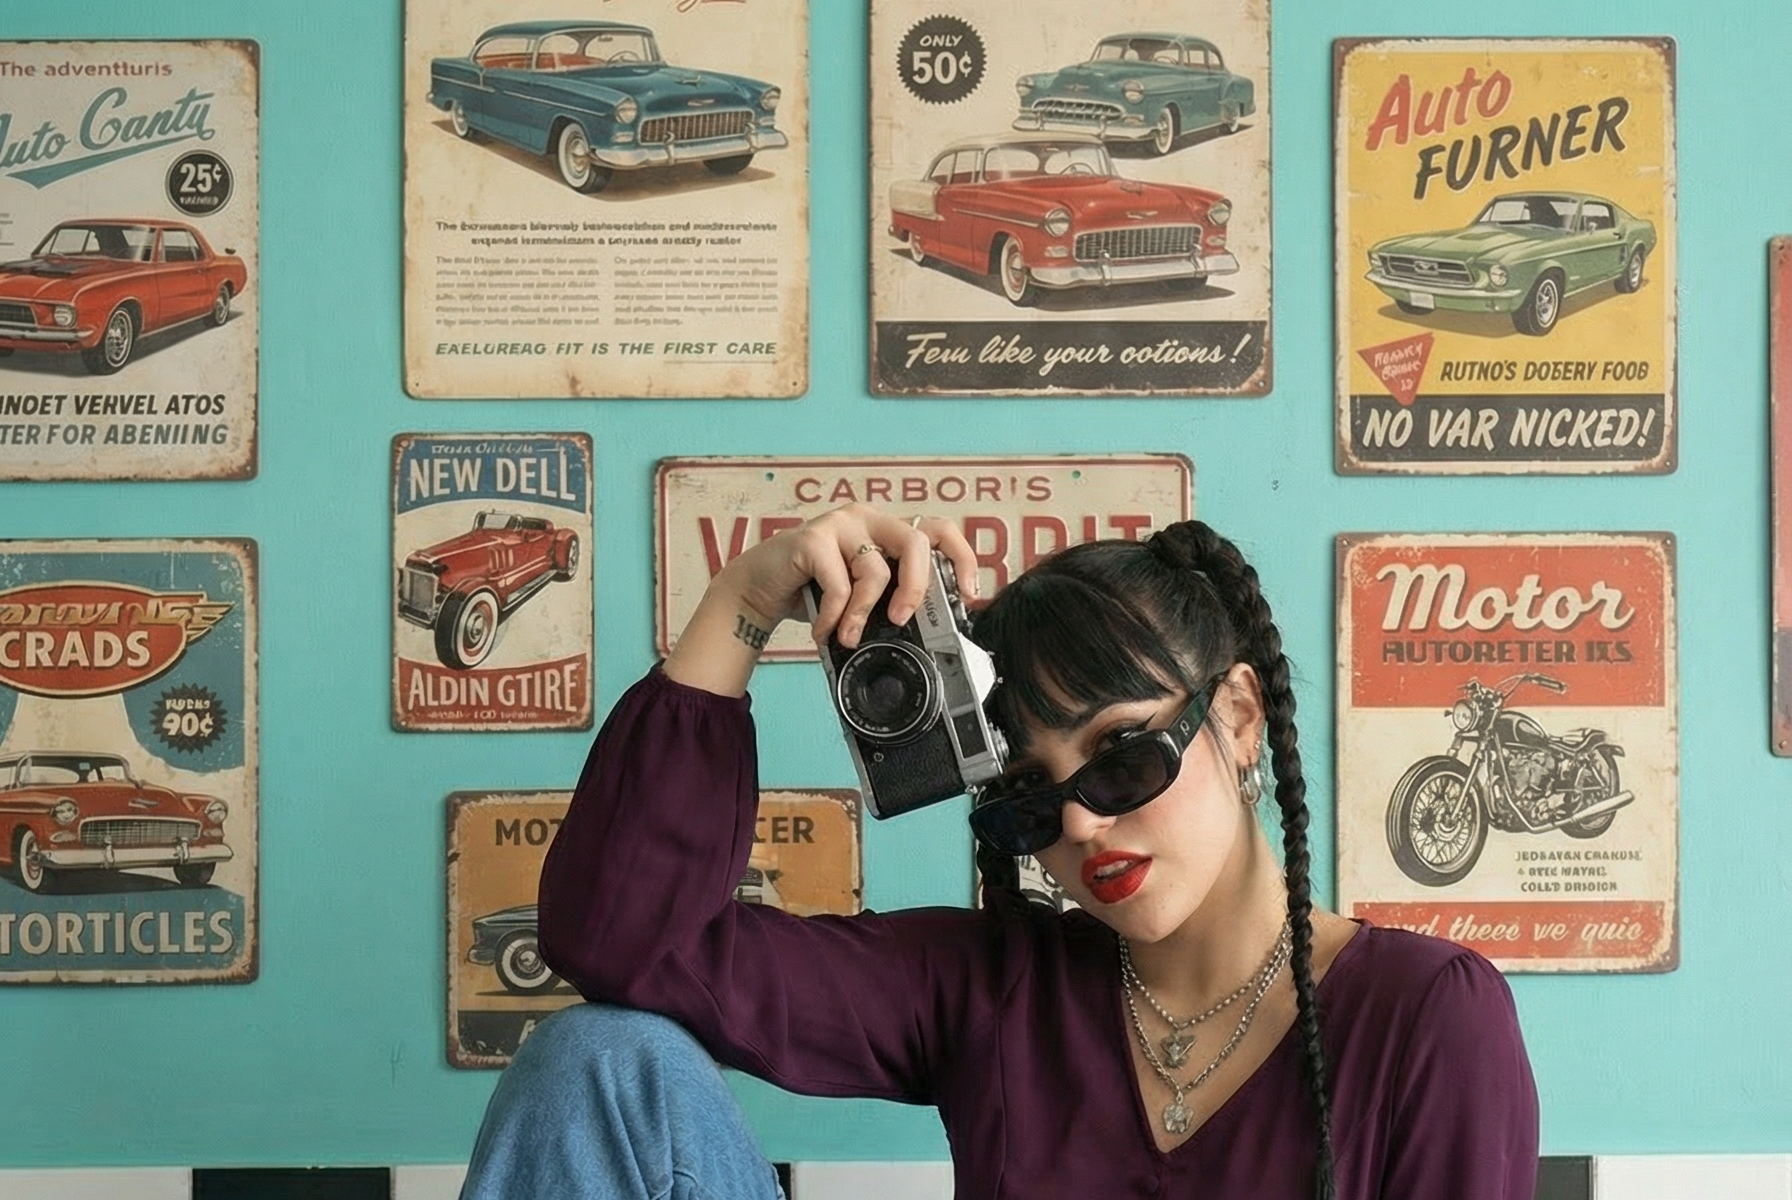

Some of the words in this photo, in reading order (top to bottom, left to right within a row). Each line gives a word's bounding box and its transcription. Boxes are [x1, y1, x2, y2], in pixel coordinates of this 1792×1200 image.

[919, 34, 963, 48] ONLY
[0, 61, 36, 77] The
[912, 50, 973, 84] 50¢
[1364, 66, 1513, 152] Auto
[1413, 96, 1630, 200] FURNER
[179, 163, 223, 194] 25¢
[591, 342, 610, 356] IS
[619, 342, 656, 356] THE
[664, 342, 719, 356] FIRST
[726, 342, 778, 356] CARE
[978, 334, 1037, 364] like
[1039, 344, 1114, 377] your
[164, 394, 226, 416] ATOS
[46, 424, 97, 445] FOR
[1362, 407, 1414, 448] NO
[1428, 407, 1500, 451] VAR
[1509, 407, 1657, 449] NICKED!
[410, 457, 482, 501] NEW
[496, 448, 577, 501] DELL
[1375, 562, 1636, 631] Motor
[0, 630, 151, 669] CRADS
[407, 668, 490, 711] ALDIN
[497, 662, 579, 712] GTIRE
[0, 910, 234, 956] TORTICLES
[1533, 921, 1570, 942] we
